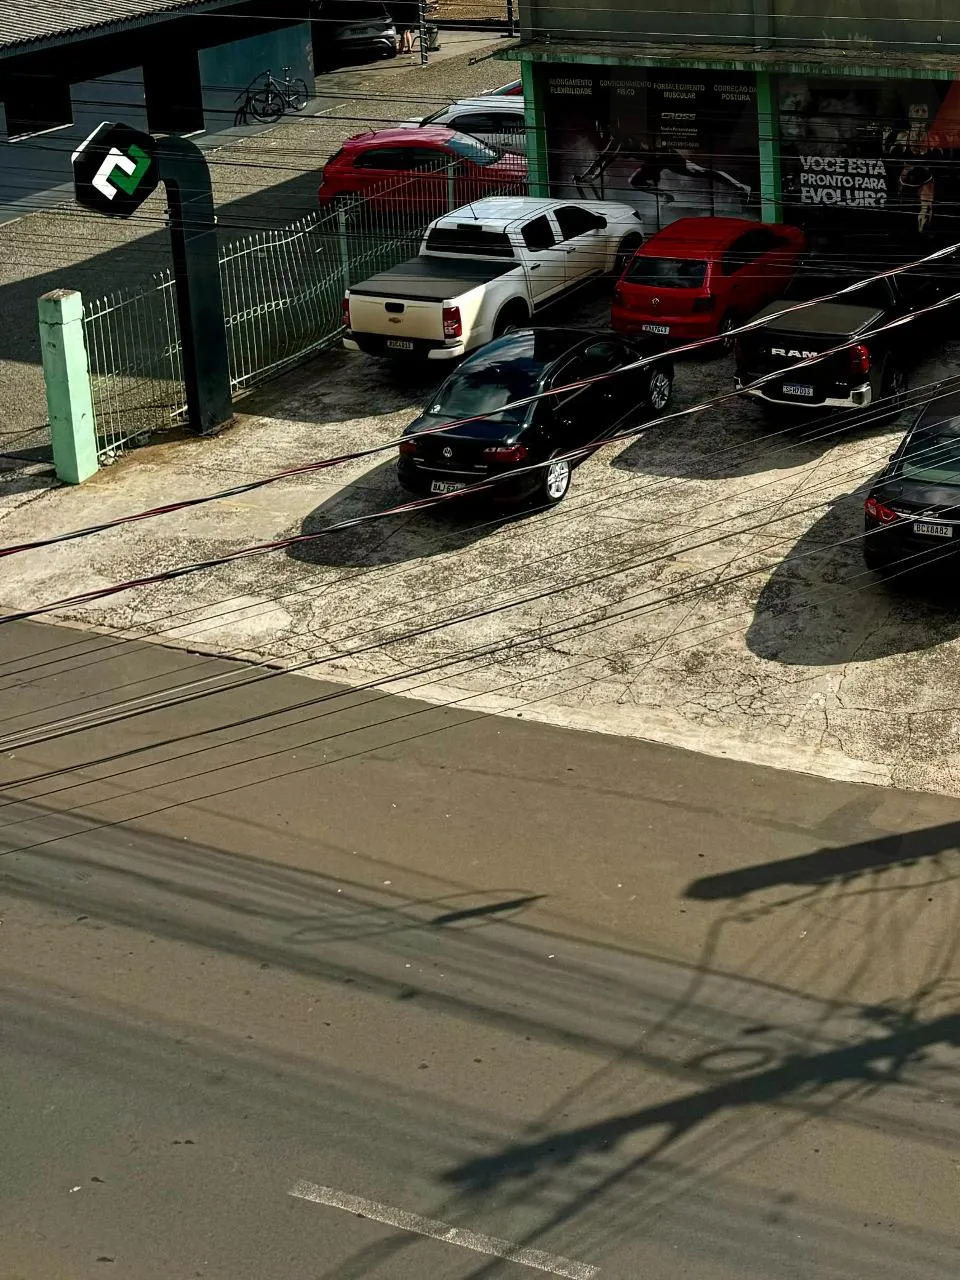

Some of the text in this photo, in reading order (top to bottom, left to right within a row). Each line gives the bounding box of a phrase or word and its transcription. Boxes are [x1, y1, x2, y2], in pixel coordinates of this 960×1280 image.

[800, 173, 888, 190] PRONTO PARA
[800, 187, 888, 208] EVOLUIR?
[771, 348, 818, 358] RAM
